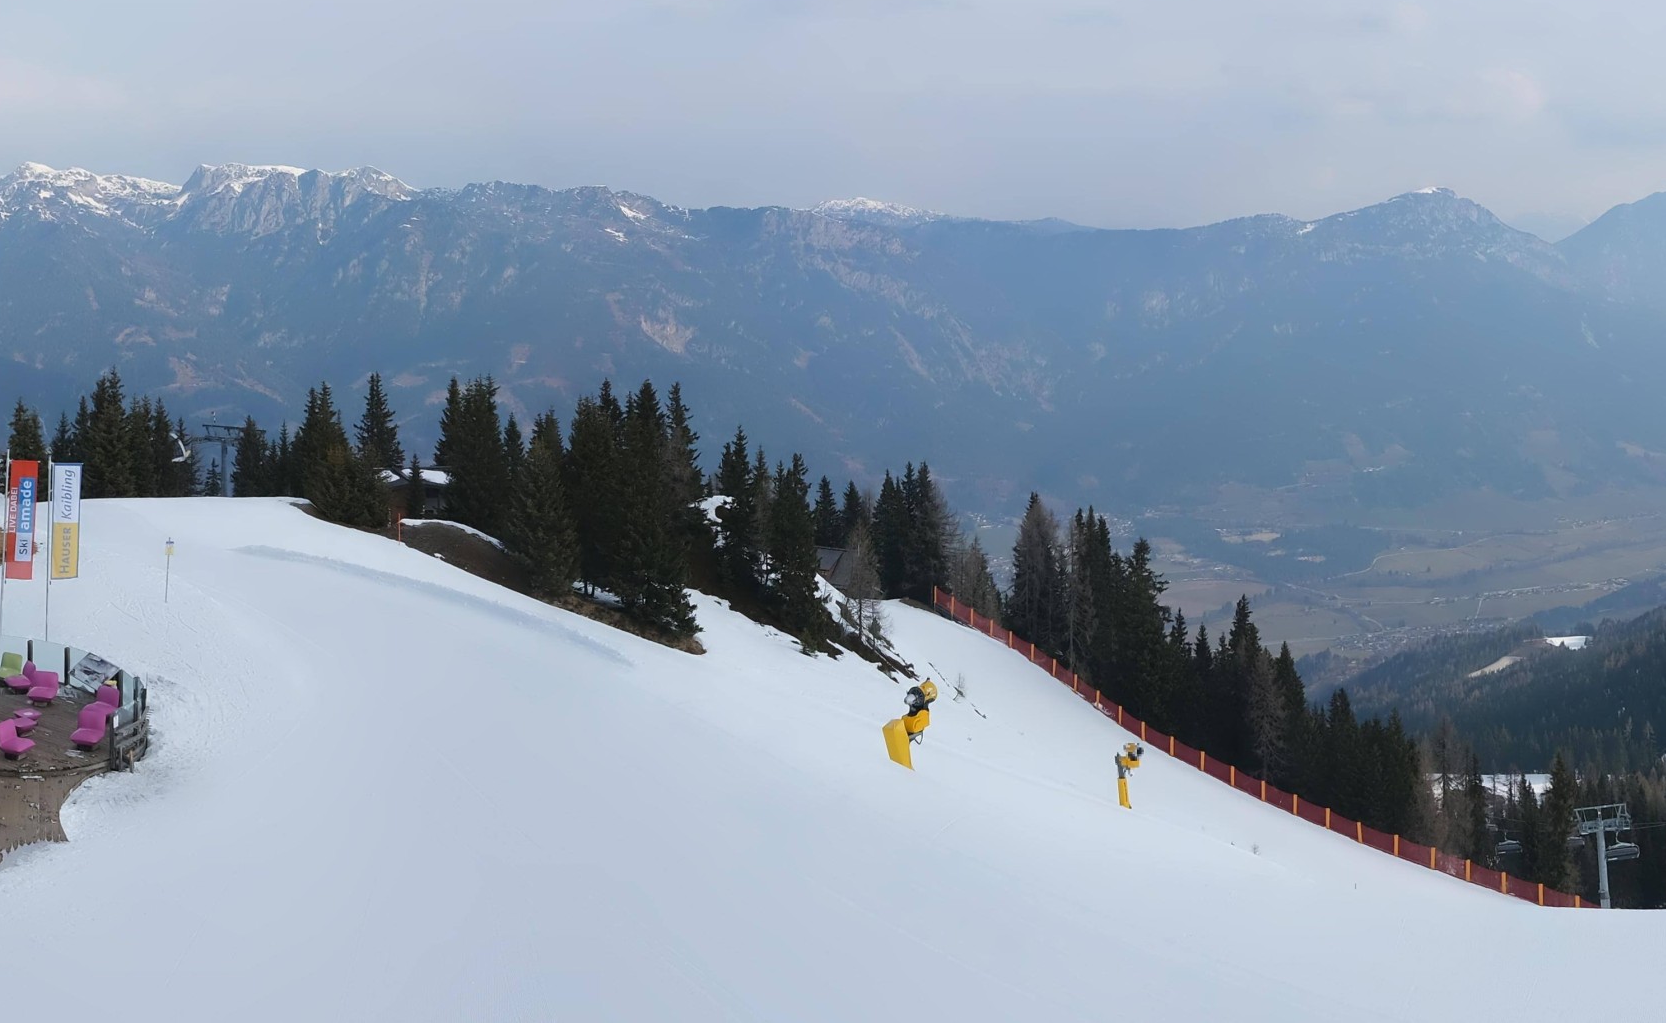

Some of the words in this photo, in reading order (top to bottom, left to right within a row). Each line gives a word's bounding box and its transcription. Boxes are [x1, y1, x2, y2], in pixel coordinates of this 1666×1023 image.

[10, 487, 19, 511] DABEI
[61, 469, 76, 520] Kaibling
[8, 511, 17, 533] LIVE
[19, 539, 28, 555] Ski
[60, 527, 71, 574] HAUSER
